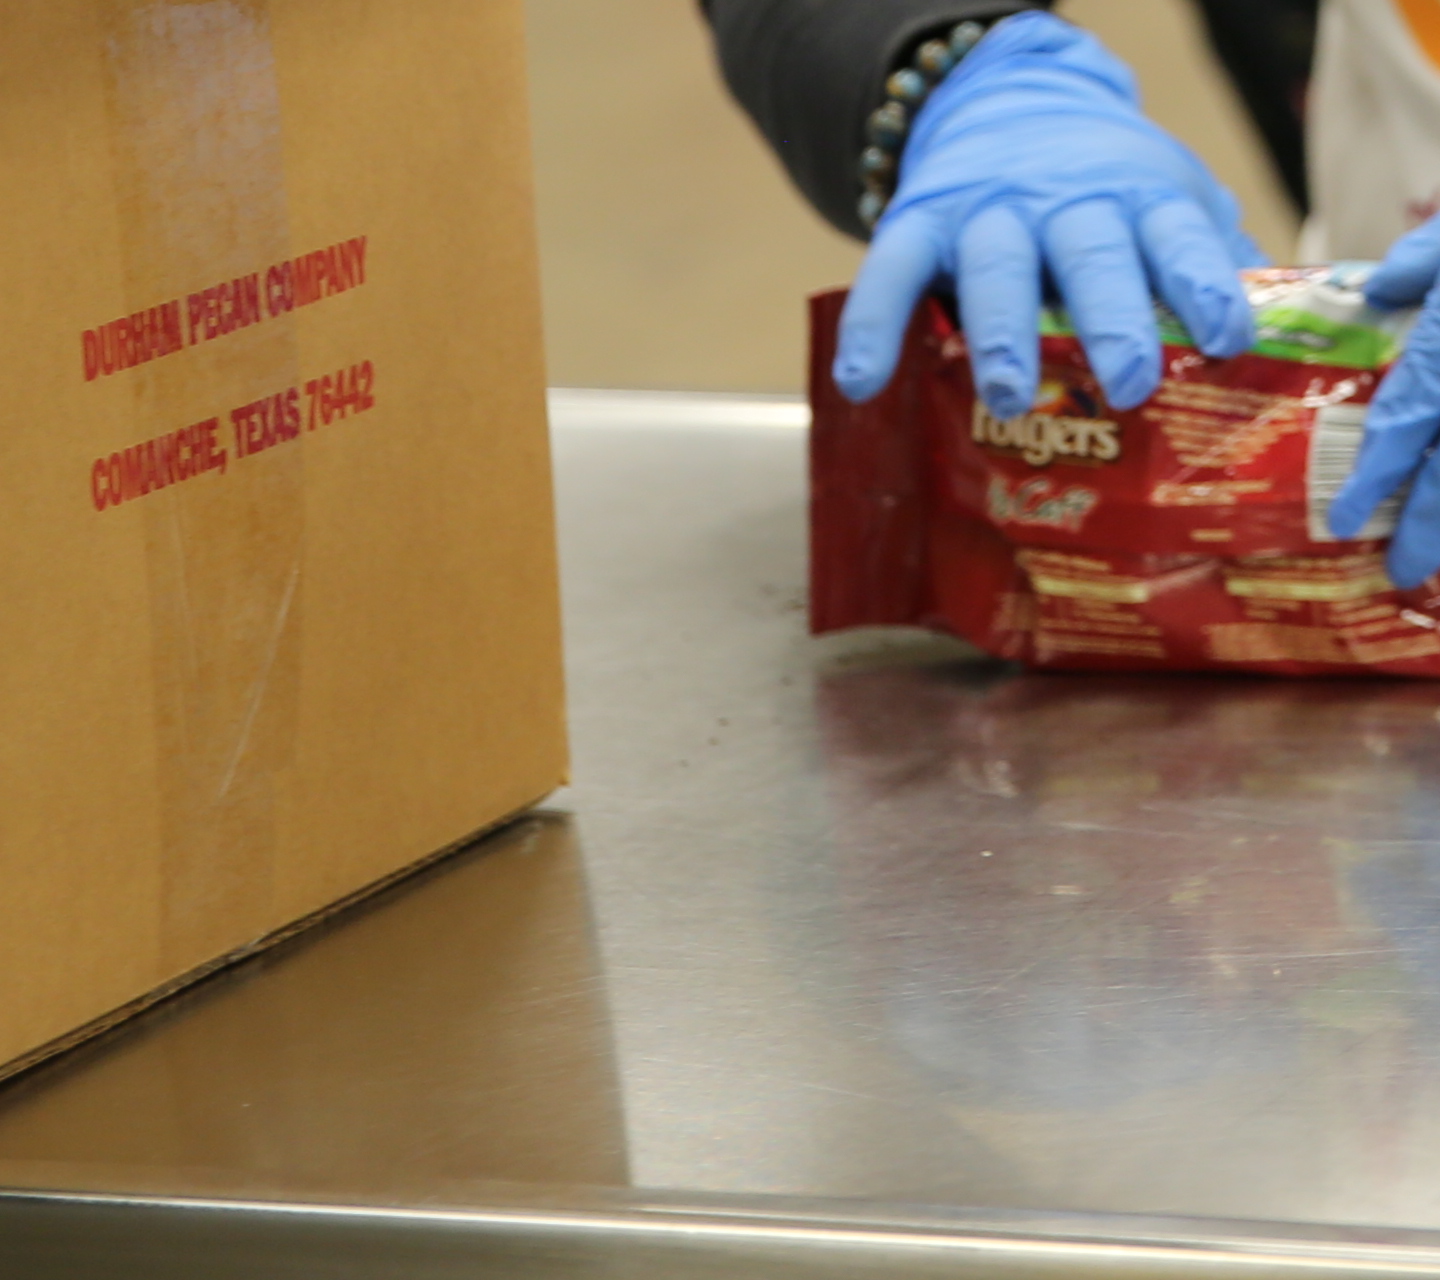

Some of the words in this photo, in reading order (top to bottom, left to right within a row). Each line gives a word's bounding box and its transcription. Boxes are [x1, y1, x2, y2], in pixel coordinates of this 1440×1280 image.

[81, 299, 184, 382] DURHAM
[187, 272, 261, 346] PECAN
[265, 235, 367, 318] COMPANY
[91, 417, 227, 512] COMANCHE,
[230, 386, 301, 459] TEXAS
[304, 360, 375, 432] 76442
